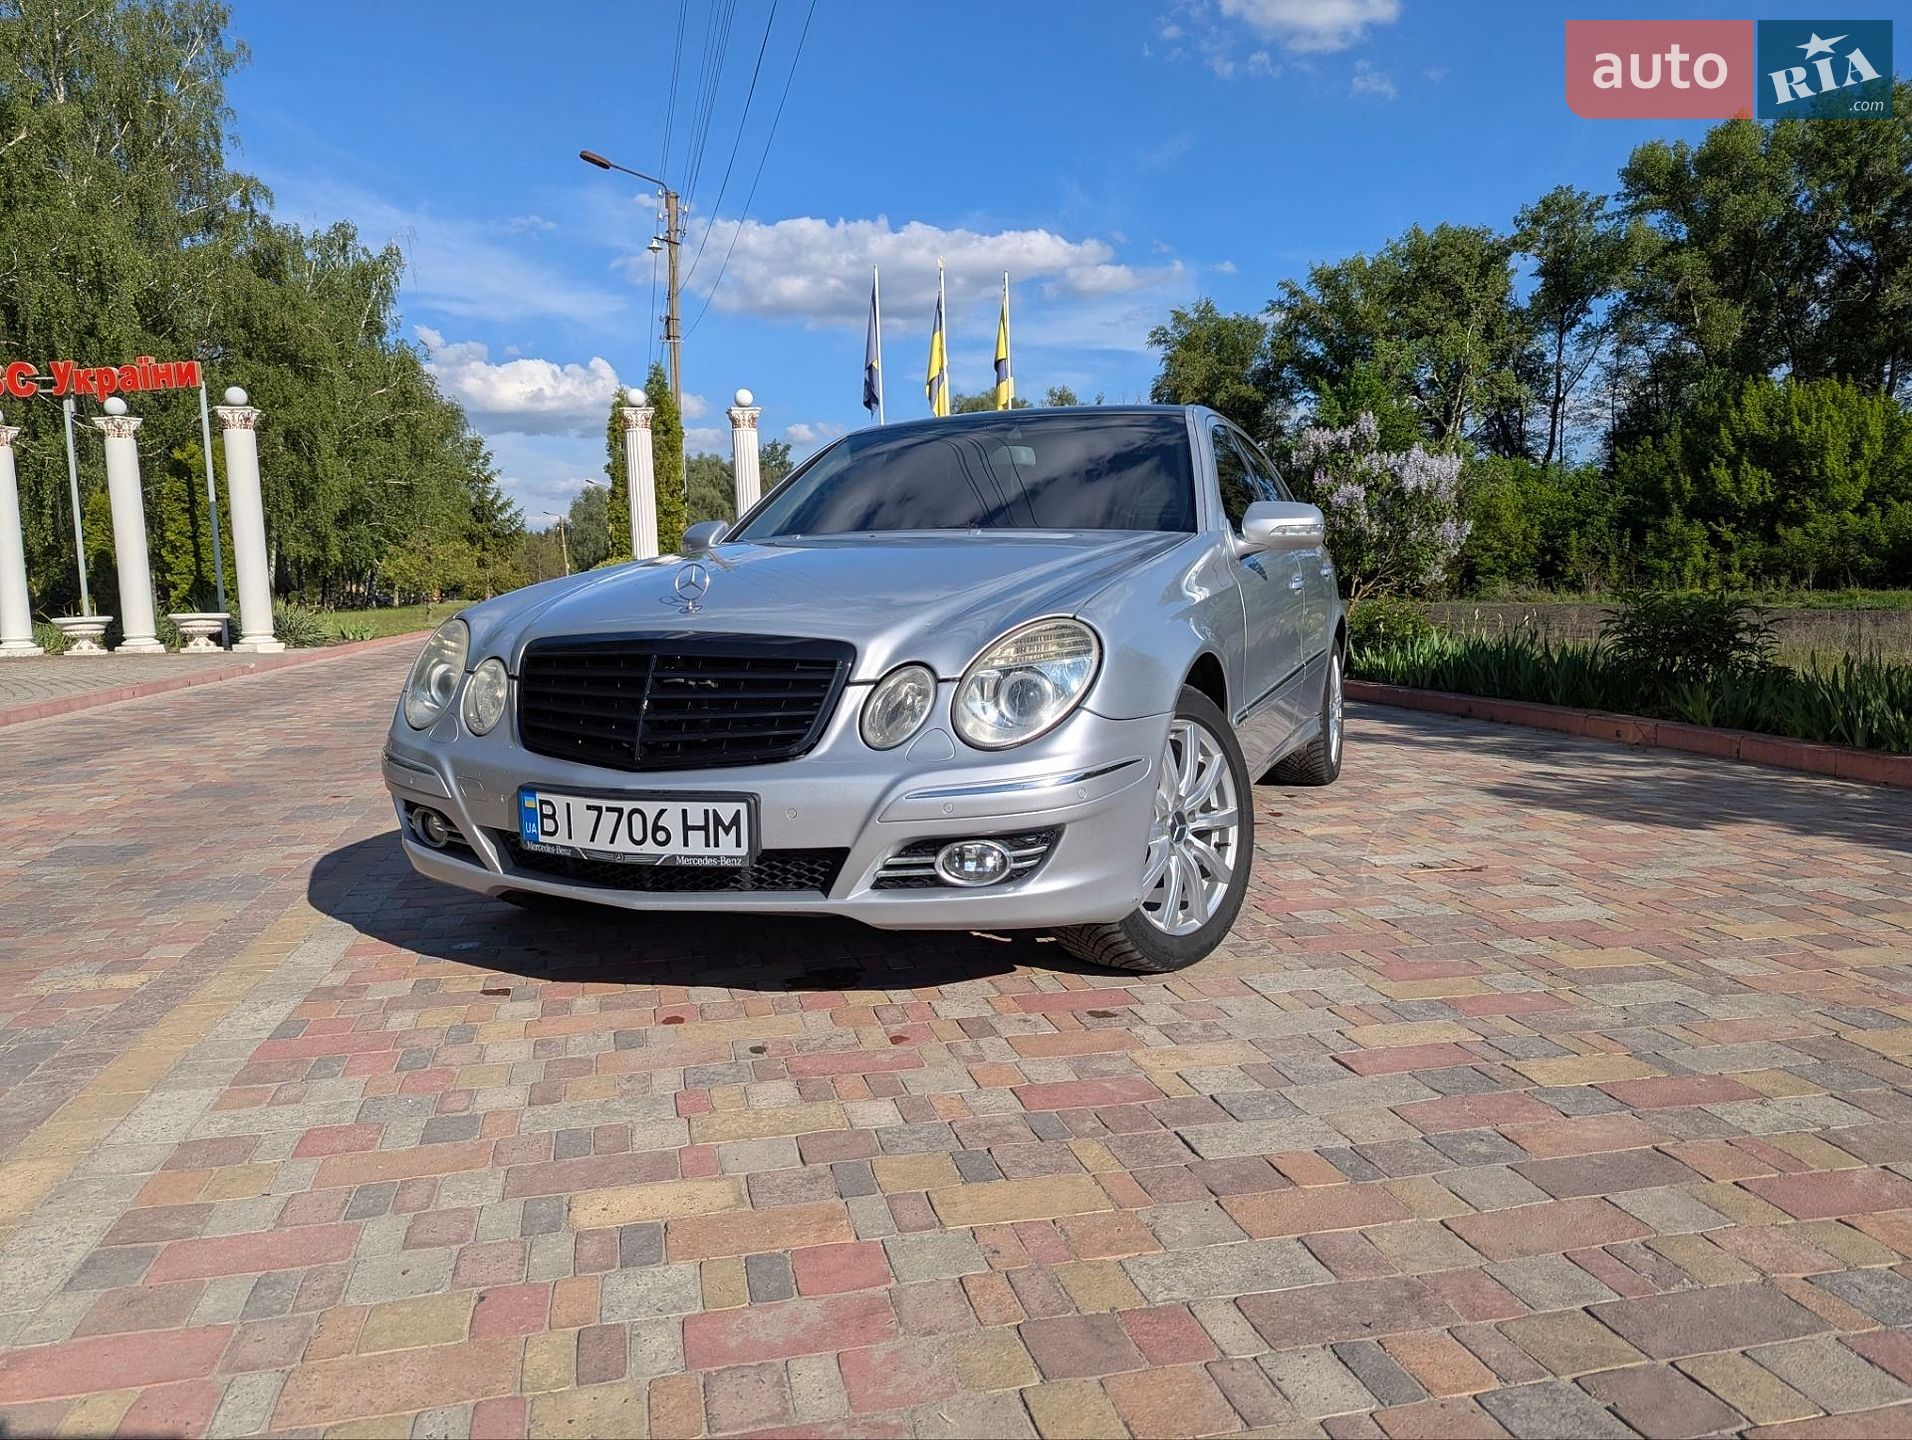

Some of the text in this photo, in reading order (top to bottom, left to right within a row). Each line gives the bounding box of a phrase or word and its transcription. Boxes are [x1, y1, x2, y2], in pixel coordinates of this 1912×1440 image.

[0, 356, 201, 401] С України
[525, 822, 538, 835] UA
[586, 804, 672, 848] 7706
[675, 855, 743, 867] Mercedes-Benz
